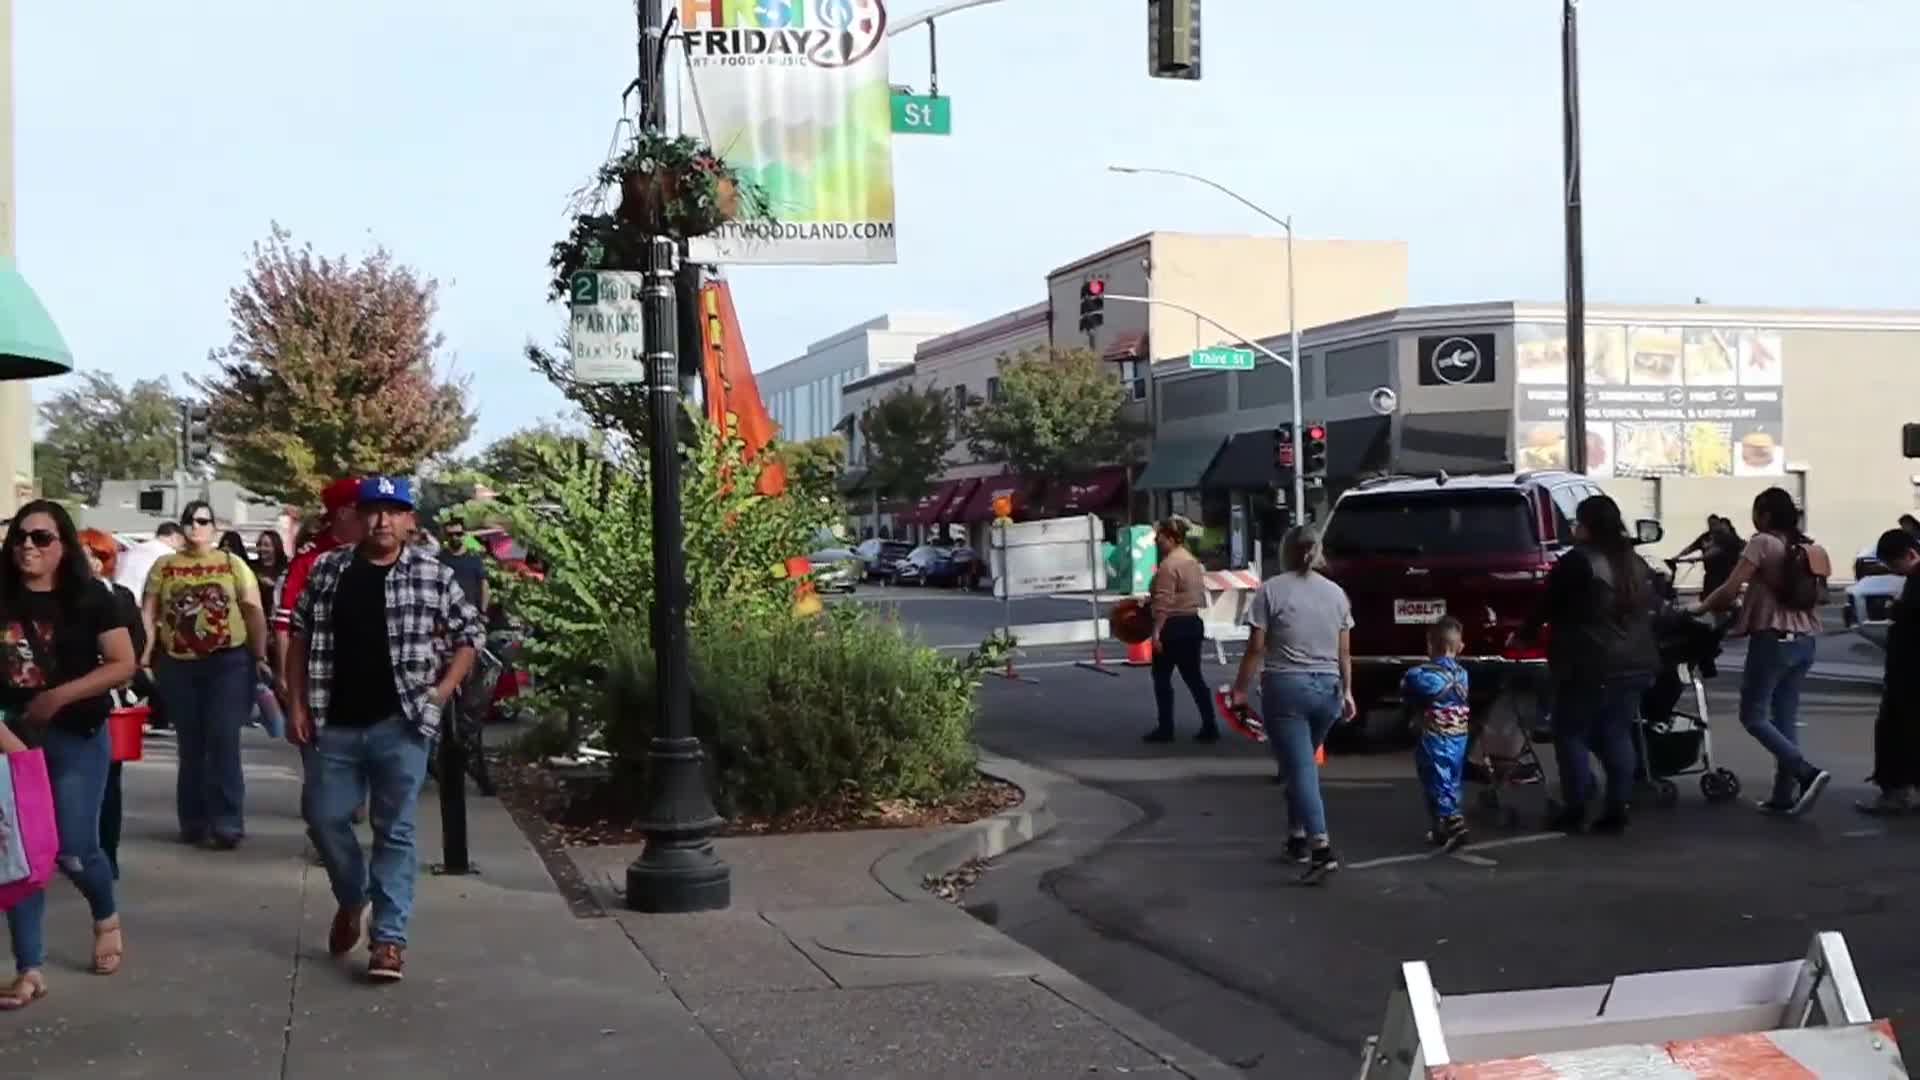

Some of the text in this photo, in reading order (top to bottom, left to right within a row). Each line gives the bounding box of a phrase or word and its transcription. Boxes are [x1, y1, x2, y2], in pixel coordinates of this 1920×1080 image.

[721, 56, 755, 65] FOOD
[904, 103, 932, 126] St
[576, 277, 592, 300] 2
[576, 313, 640, 334] PARKING
[1200, 352, 1245, 364] Third St
